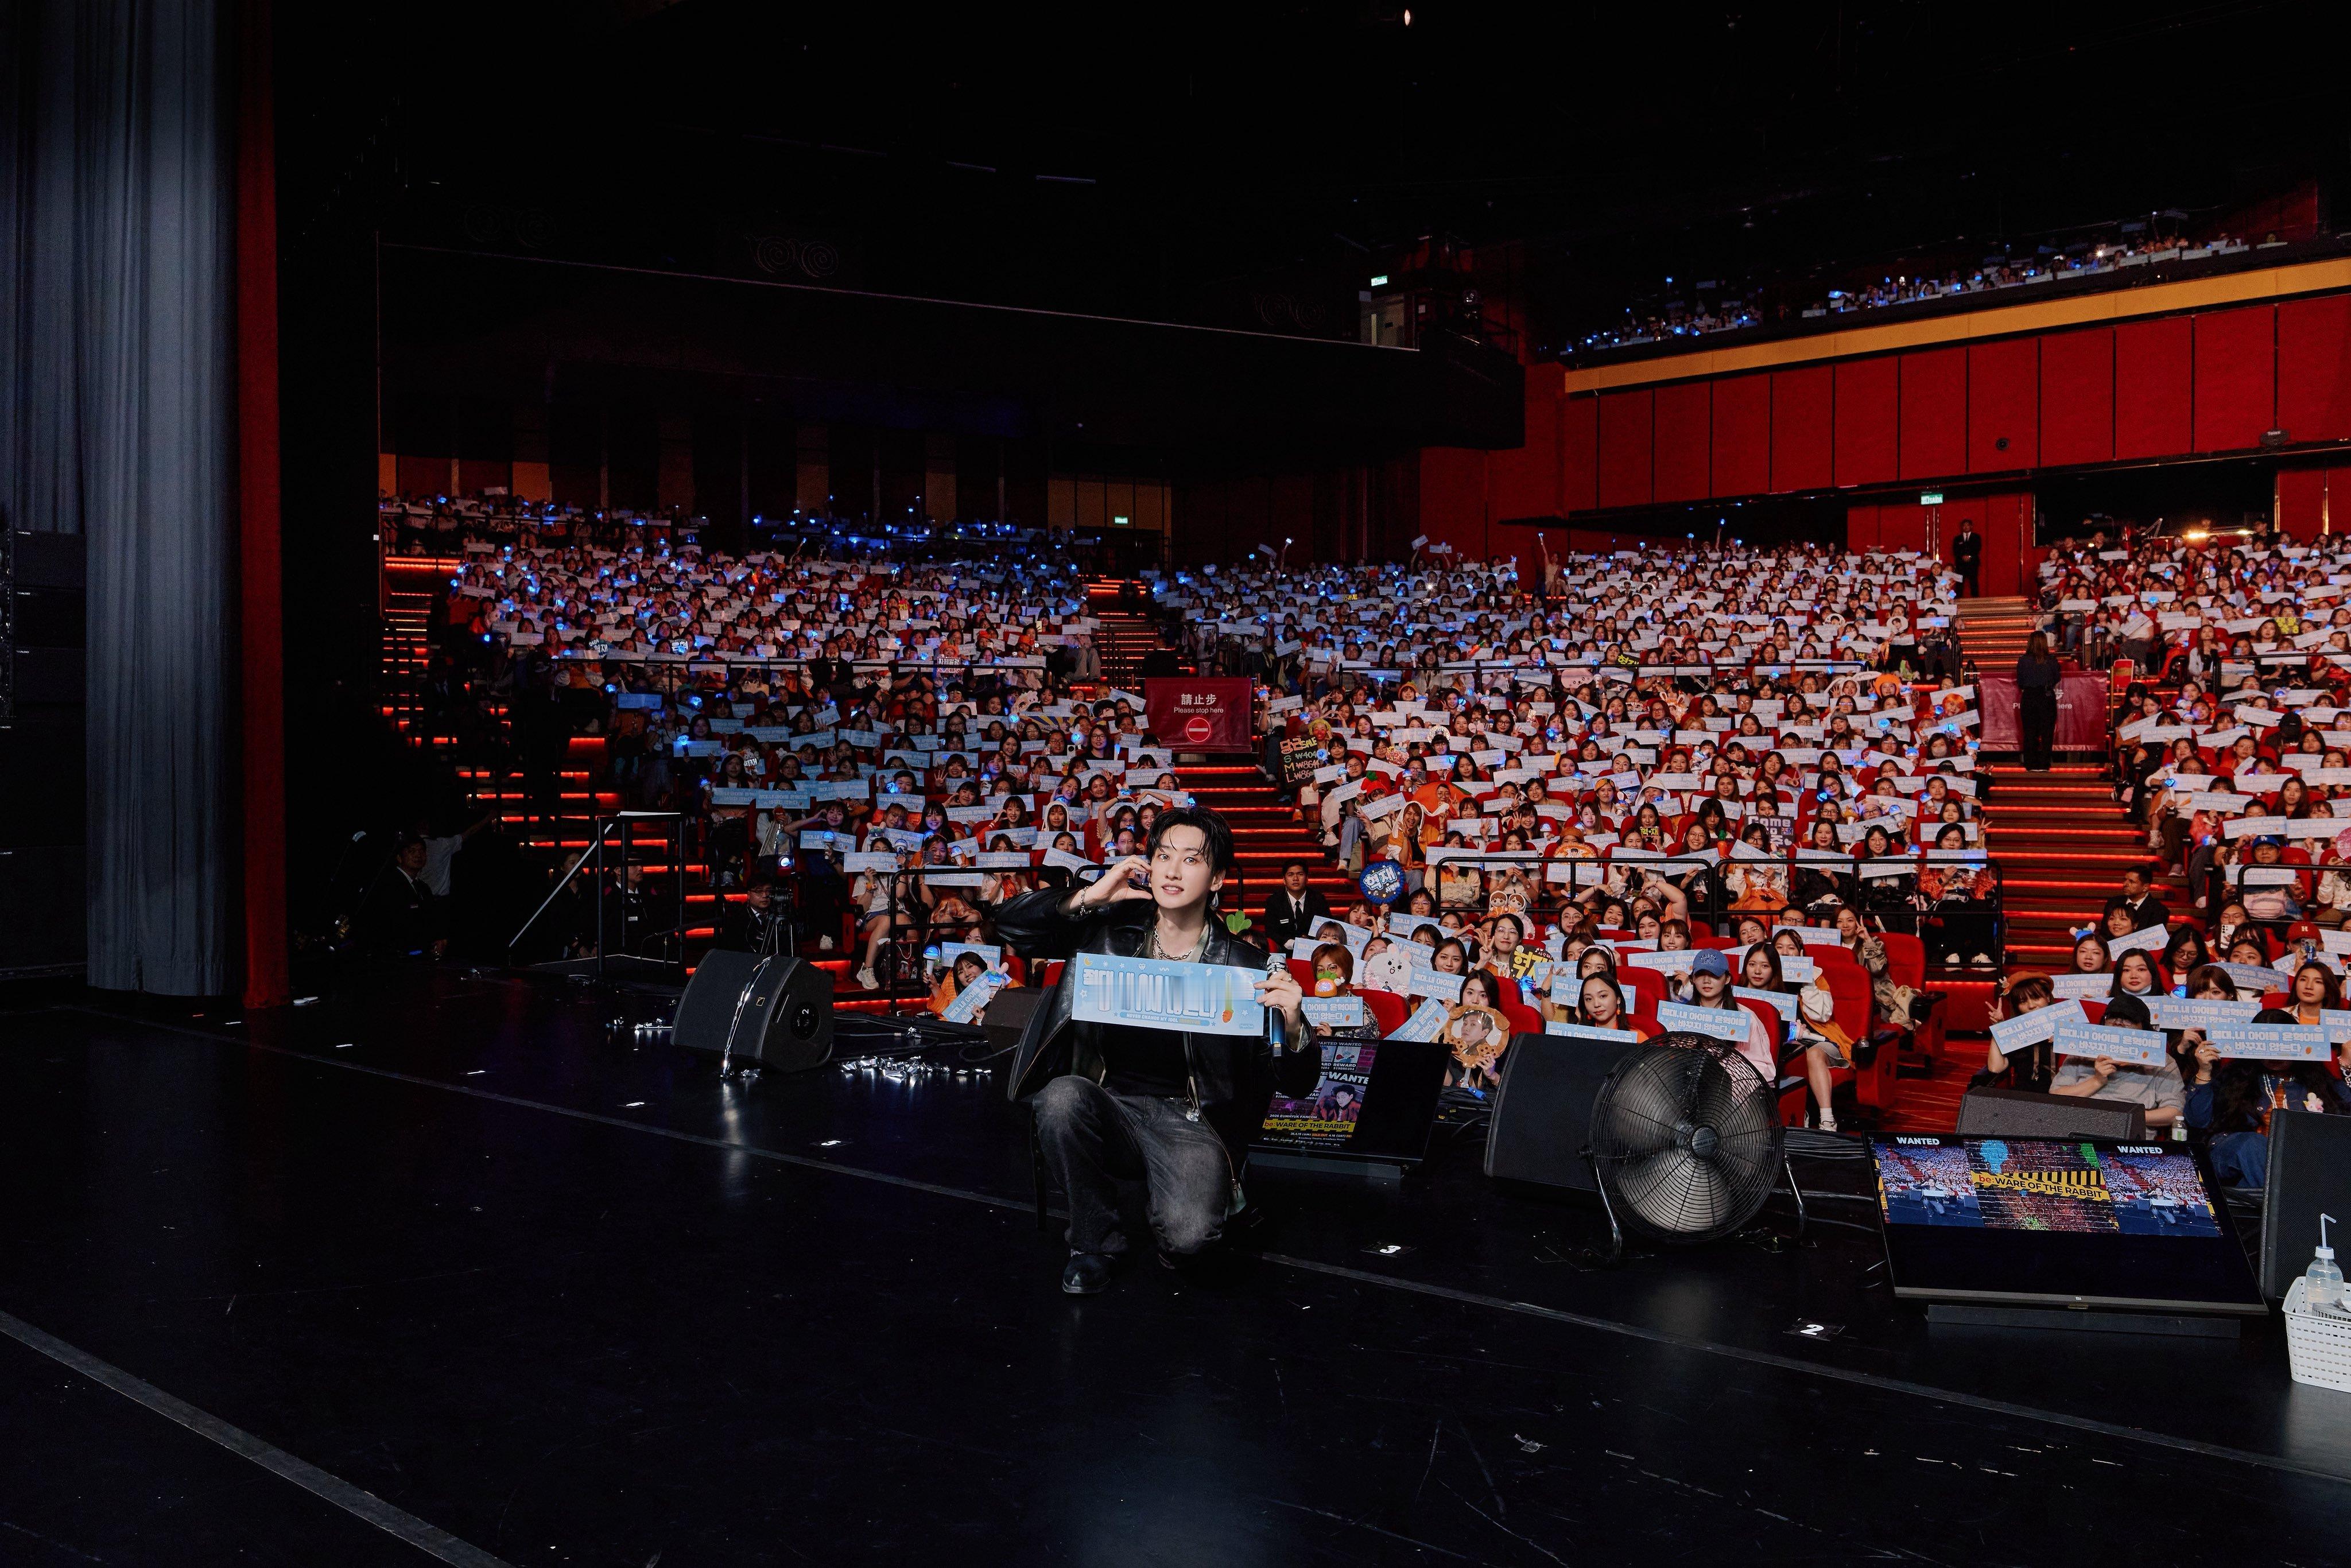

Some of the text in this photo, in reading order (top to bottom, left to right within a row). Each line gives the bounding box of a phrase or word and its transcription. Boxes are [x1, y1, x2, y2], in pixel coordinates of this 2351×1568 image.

[1181, 694, 1216, 705] 請止步
[1280, 736, 1317, 754] 당근 SALE
[1284, 763, 1295, 773] M
[1285, 774, 1294, 783] L
[1748, 816, 1791, 827] Come
[1364, 866, 1396, 890] 혁재
[1414, 973, 1456, 987] 절대,내 아이돌
[1426, 984, 1446, 995] 바꾸지
[1329, 1003, 1359, 1011] 은혁이를
[1419, 1003, 1438, 1022] 은혁이를
[2163, 1004, 2257, 1018] 절대,내 아이돌 은혁이를
[1320, 1012, 1343, 1022] 않는다
[1661, 1008, 1746, 1027] 절대,내 아이돌 은혁이를
[1996, 1006, 2079, 1038] 절대,내 아이돌 은혁이를
[2181, 1014, 2207, 1023] 바꾸지
[1677, 1020, 1728, 1034] 바꾸지 않는다
[2018, 1028, 2042, 1041] 바꾸지
[2059, 1027, 2162, 1049] 절대,내 아이돌 은혁이를
[2212, 1030, 2325, 1042] 절대,내 아이돌 은혁이를
[2079, 1041, 2139, 1057] 바꾸지 않는다
[2234, 1042, 2302, 1053] 바꾸지 않는다
[1896, 1137, 1939, 1146] WANTED
[2117, 1146, 2163, 1154] WANTED
[1978, 1174, 2102, 1198] be:WARE OF THE RABBIT
